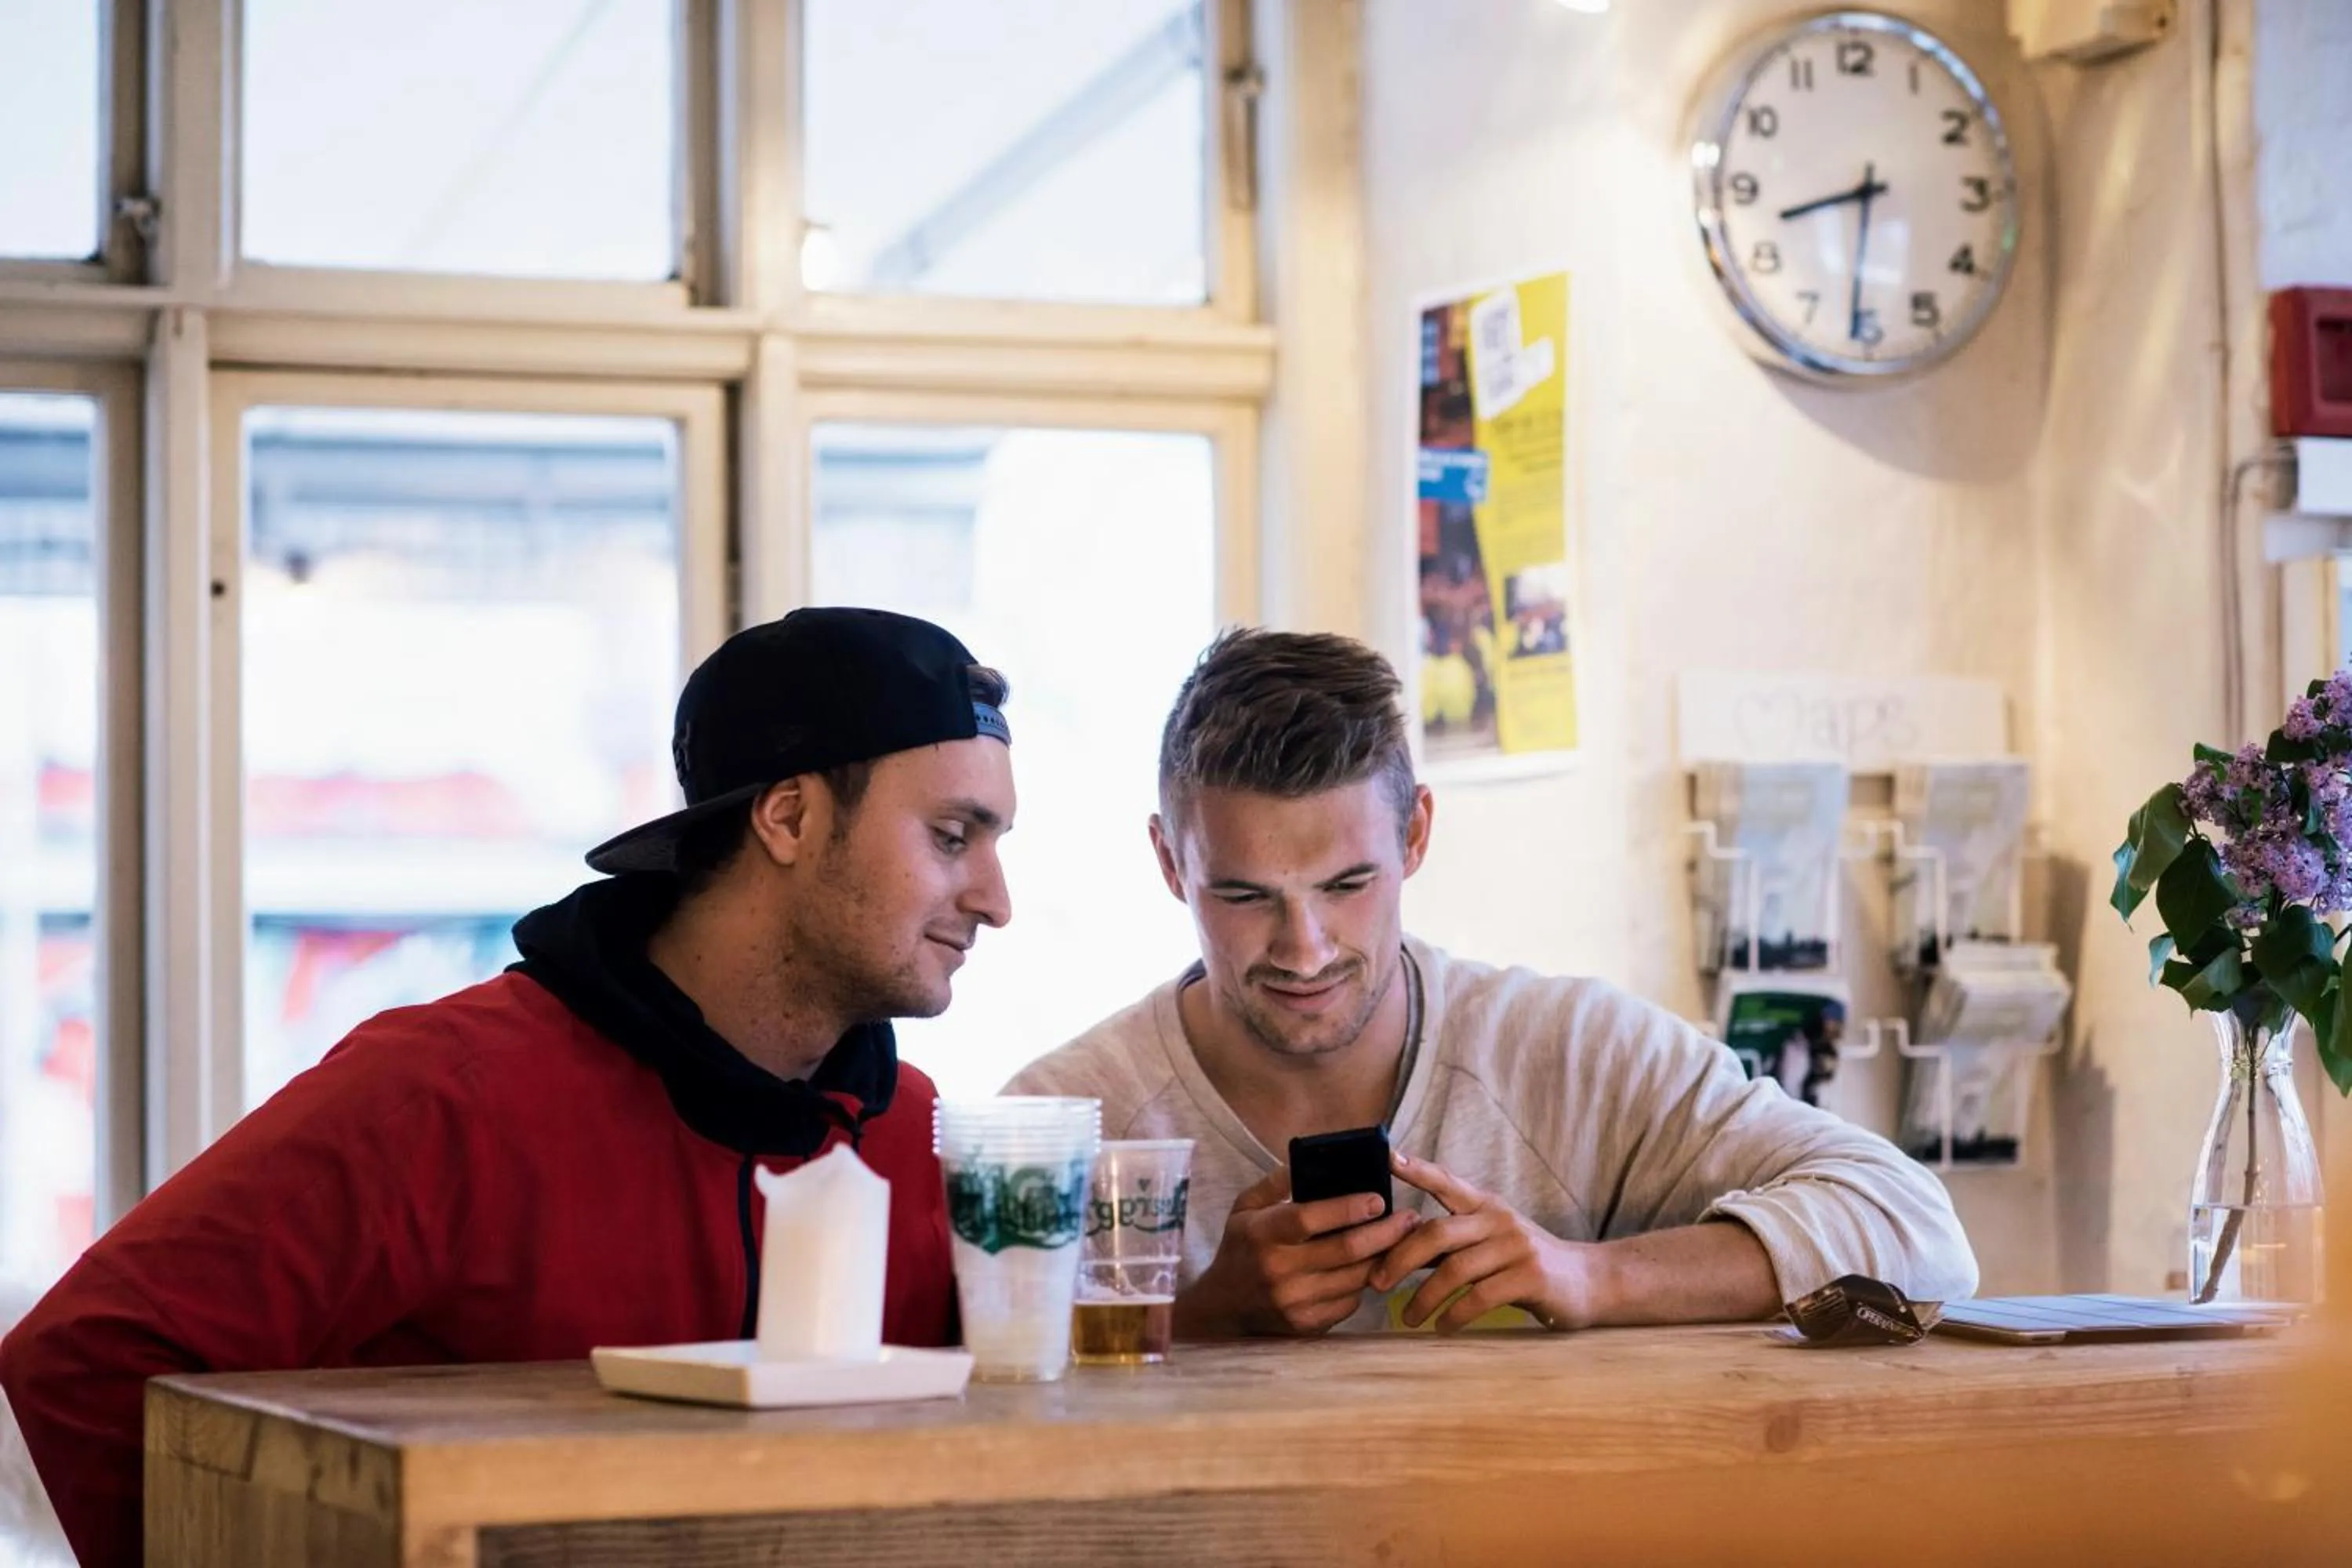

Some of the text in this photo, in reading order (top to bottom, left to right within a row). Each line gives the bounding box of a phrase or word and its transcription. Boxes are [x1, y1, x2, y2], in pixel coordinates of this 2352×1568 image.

[1791, 59, 1813, 91] 11
[1837, 42, 1875, 76] 12
[1908, 61, 1919, 94] 1
[1748, 106, 1778, 137] 10
[1940, 110, 1969, 145] 2
[1731, 172, 1759, 205] 9
[1962, 176, 1991, 212] 3
[1751, 241, 1781, 274] 8
[1948, 244, 1976, 275] 4
[1797, 290, 1820, 325] 7
[1911, 292, 1940, 327] 5
[1856, 309, 1885, 346] 6
